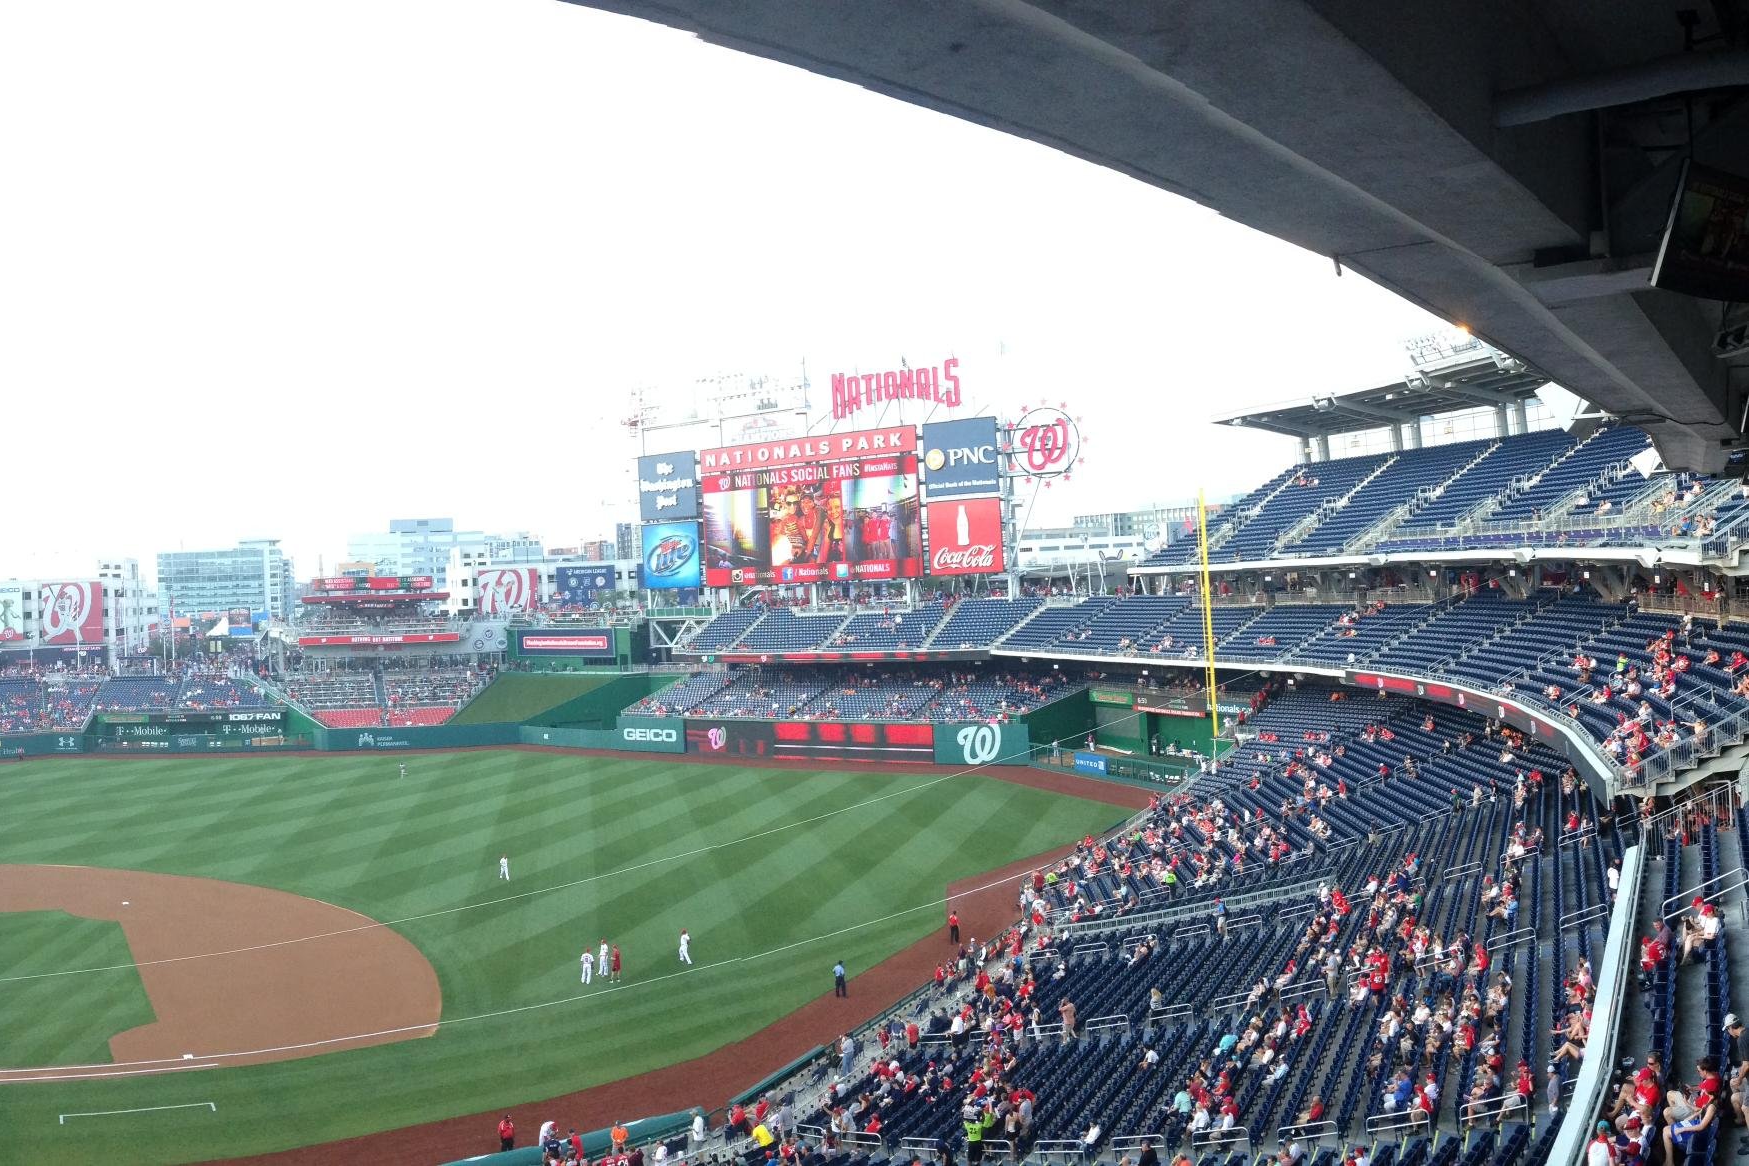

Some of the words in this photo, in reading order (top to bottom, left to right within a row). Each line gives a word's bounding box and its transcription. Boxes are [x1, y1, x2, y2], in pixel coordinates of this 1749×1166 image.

[831, 357, 961, 419] NATIONALS
[705, 440, 831, 467] NATIONALS
[842, 432, 903, 452] PARK
[947, 445, 995, 466] PNC
[735, 468, 788, 488] NATIONALS
[791, 464, 830, 482] SOCIAL
[832, 462, 860, 478] FANS
[256, 712, 281, 720] FAN
[623, 728, 676, 742] GEICO
[1075, 758, 1098, 768] UNITED
